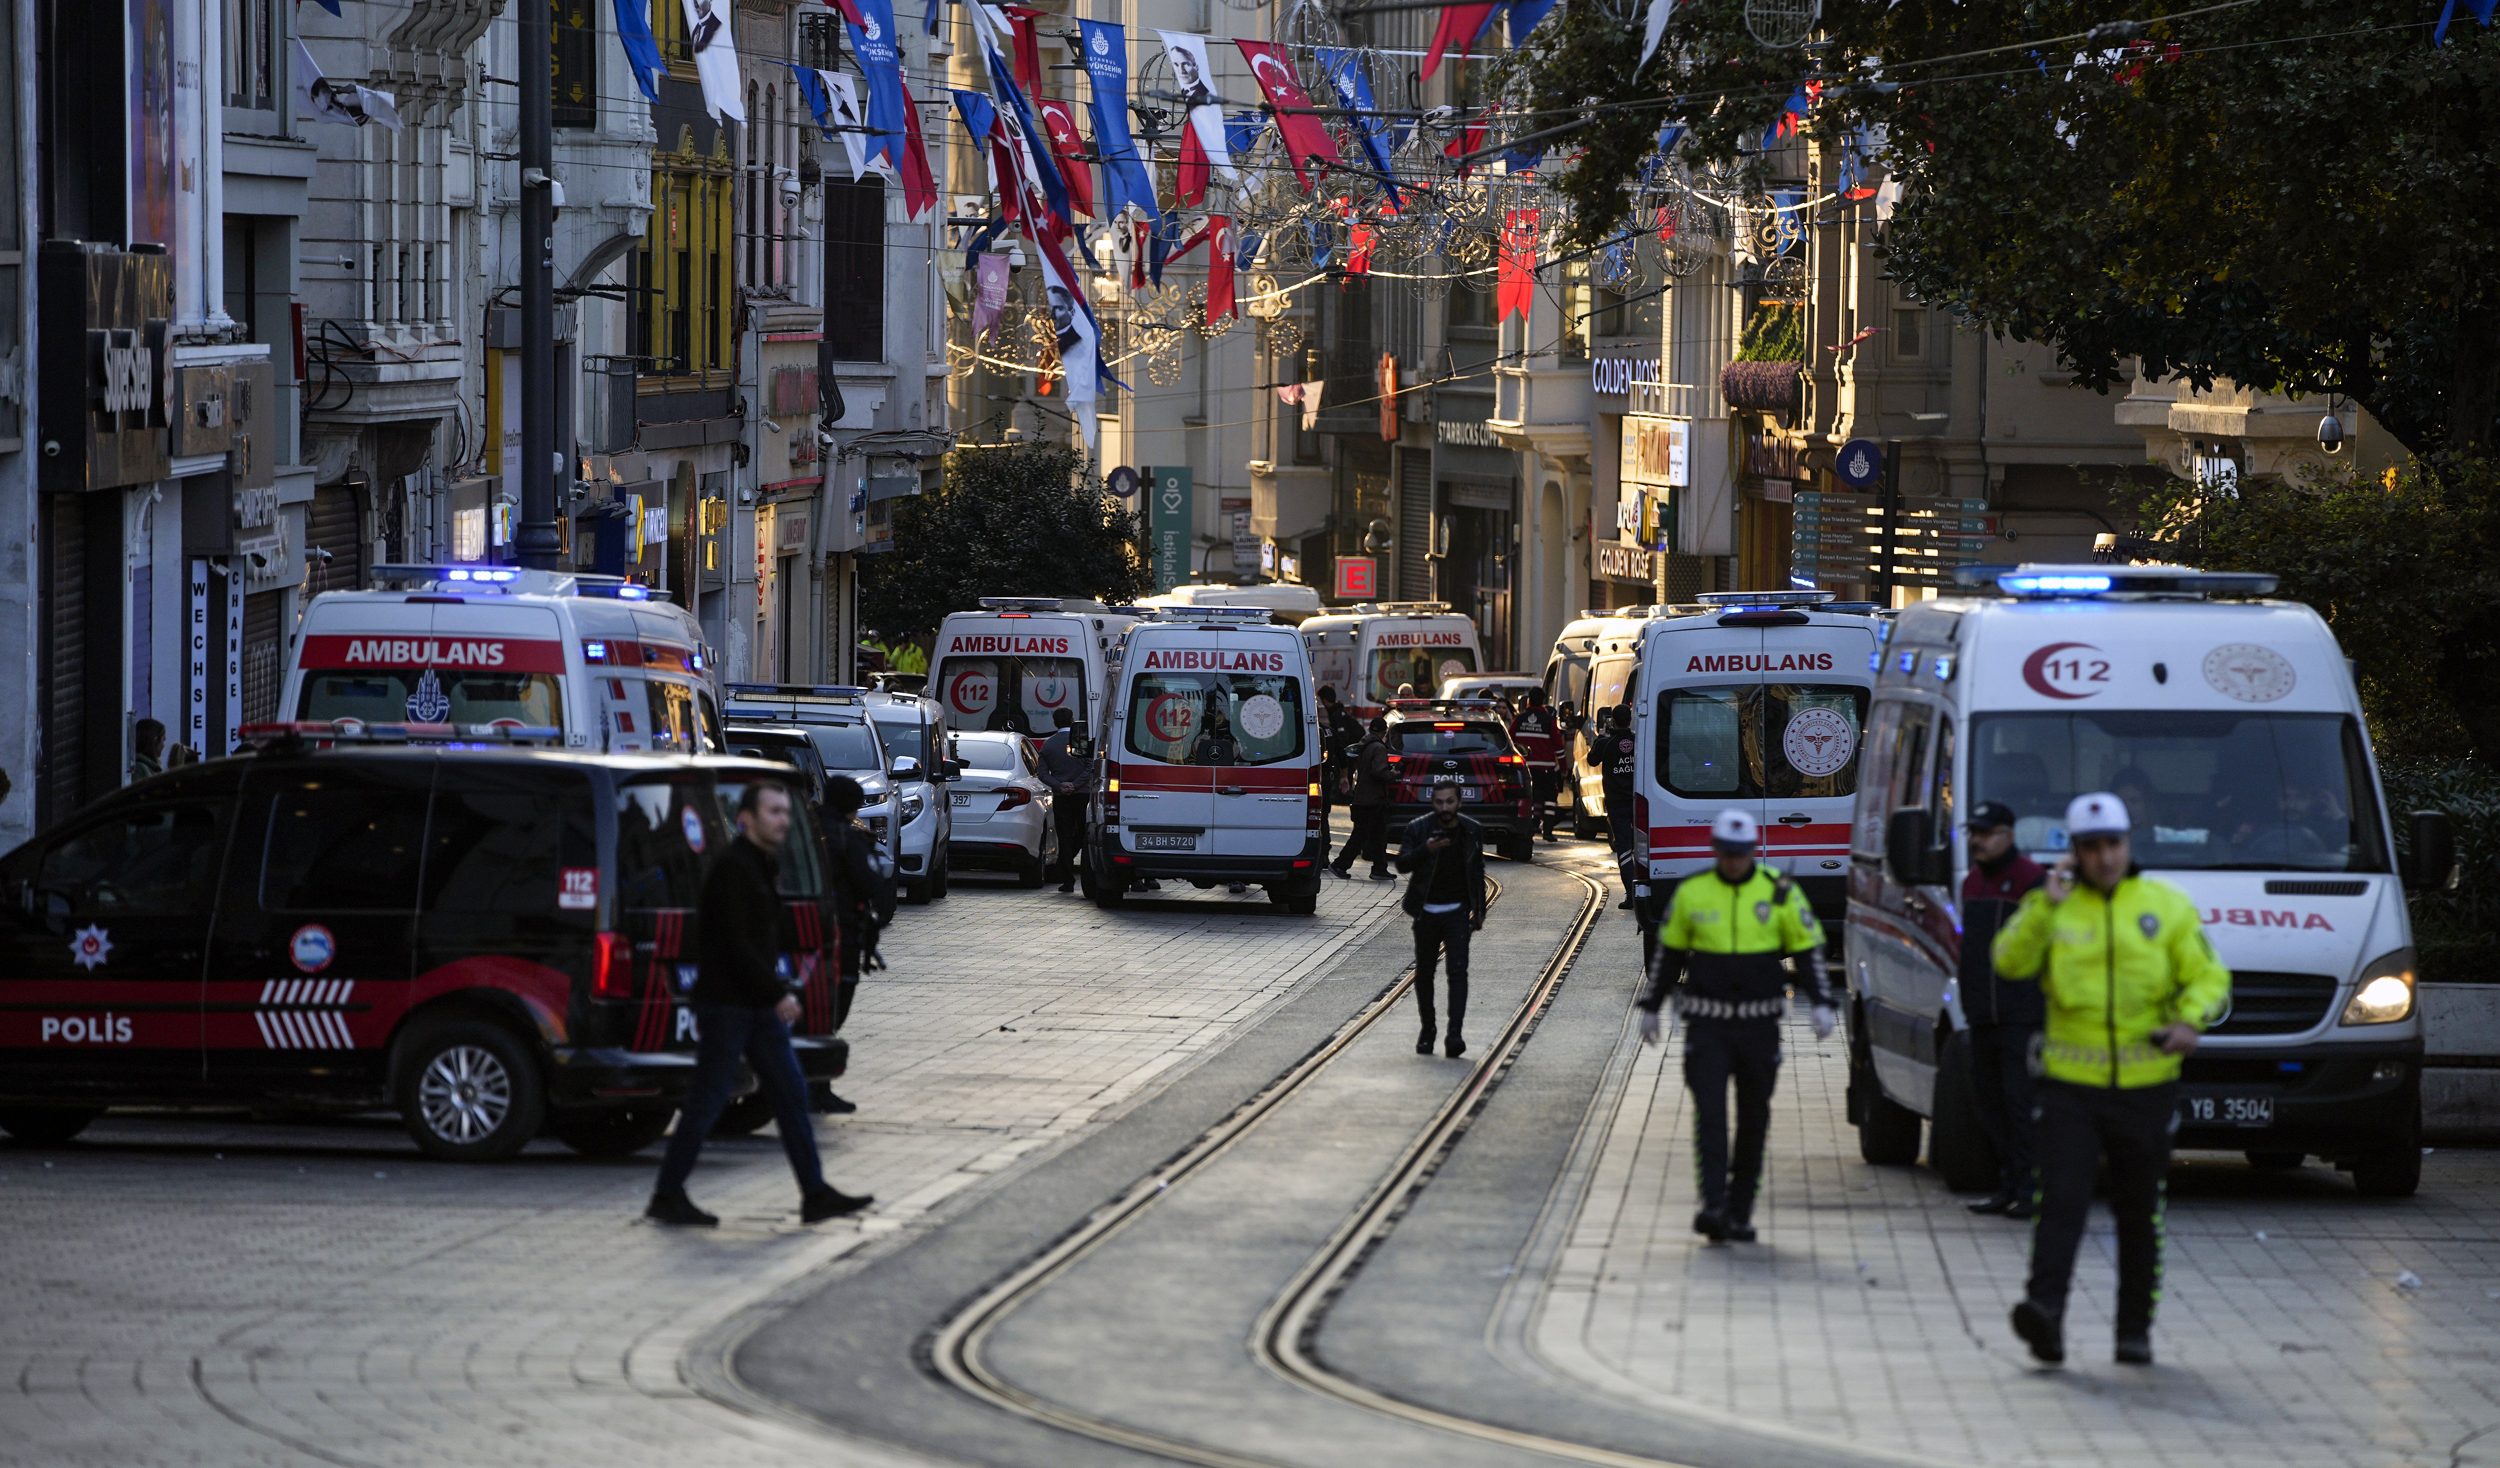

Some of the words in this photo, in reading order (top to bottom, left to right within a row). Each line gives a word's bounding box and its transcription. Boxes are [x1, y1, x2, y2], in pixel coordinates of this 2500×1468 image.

[1593, 357, 1633, 394] GOLDEN
[1636, 358, 1661, 396] ROSE
[1438, 421, 1479, 446] STARBUCKS
[1600, 549, 1629, 577] GOLDEN
[1630, 551, 1649, 579] ROSE
[1347, 566, 1370, 590] E
[231, 571, 239, 697] CHANGE
[950, 636, 1069, 653] AMBULANS
[1376, 633, 1461, 646] AMBULANS
[345, 641, 504, 666] AMBULANS
[1144, 650, 1284, 672] AMBULANS
[1686, 653, 1833, 673] AMBULANS
[2047, 660, 2110, 682] 112
[960, 684, 989, 701] 112
[1159, 708, 1192, 728] 112
[1433, 772, 1465, 783] POLİS
[953, 795, 969, 804] 397
[1141, 836, 1153, 846] 34
[1155, 836, 1168, 846] BH
[1170, 836, 1194, 846] 5720
[564, 871, 593, 893] 112
[42, 1011, 133, 1042] POLİS
[2224, 1098, 2269, 1120] 3504
